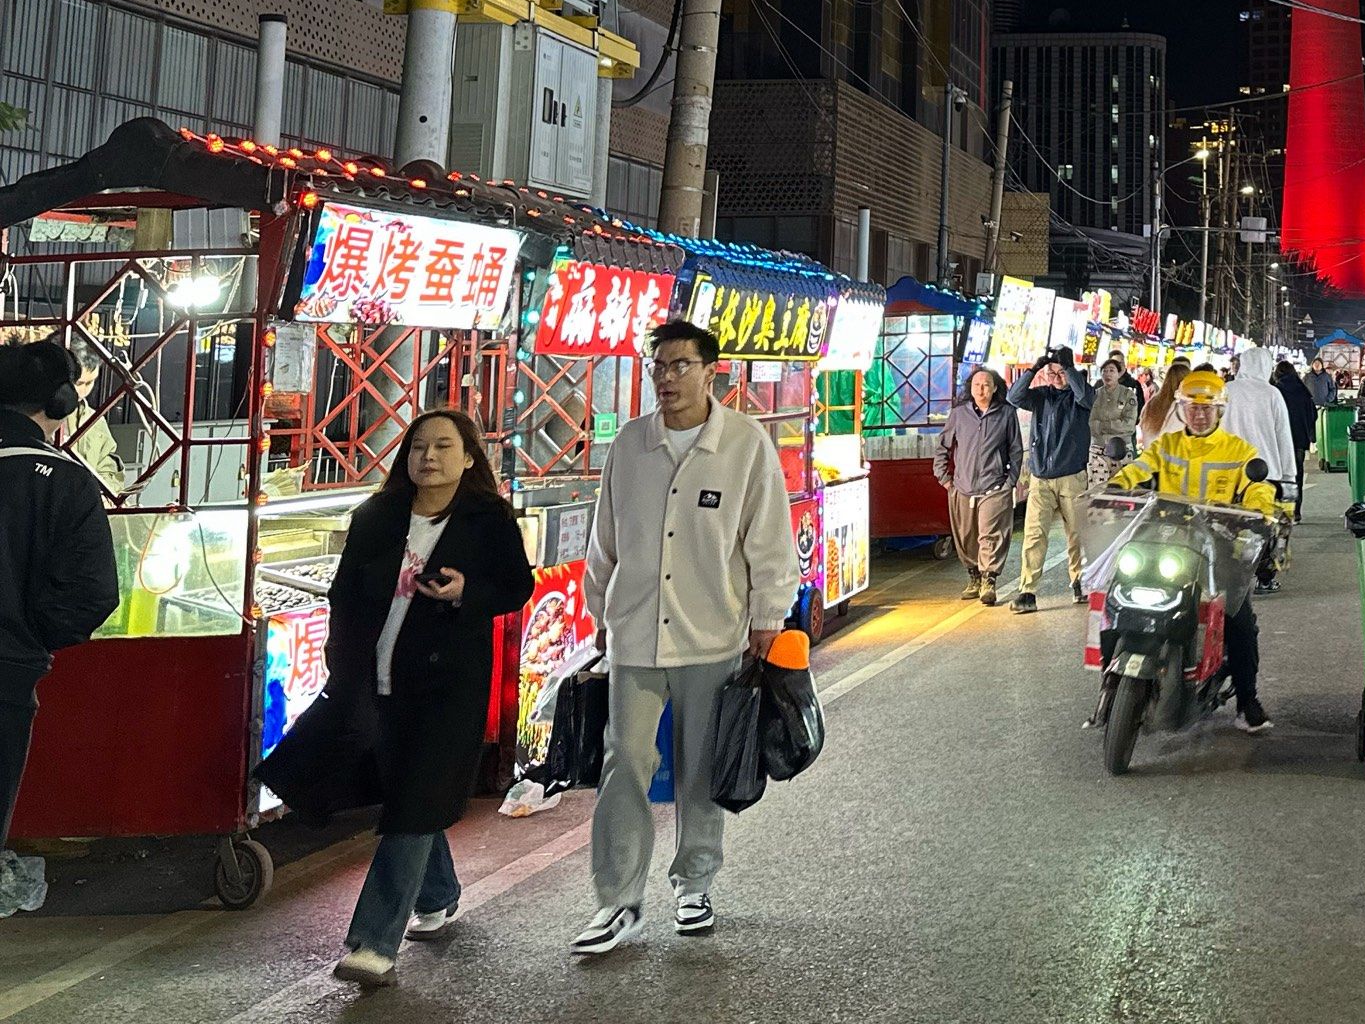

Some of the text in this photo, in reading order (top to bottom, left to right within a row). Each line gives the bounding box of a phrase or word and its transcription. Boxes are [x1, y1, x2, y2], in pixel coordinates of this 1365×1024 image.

[317, 223, 507, 307] 爆烤蚕蛹
[34, 462, 53, 477] TM
